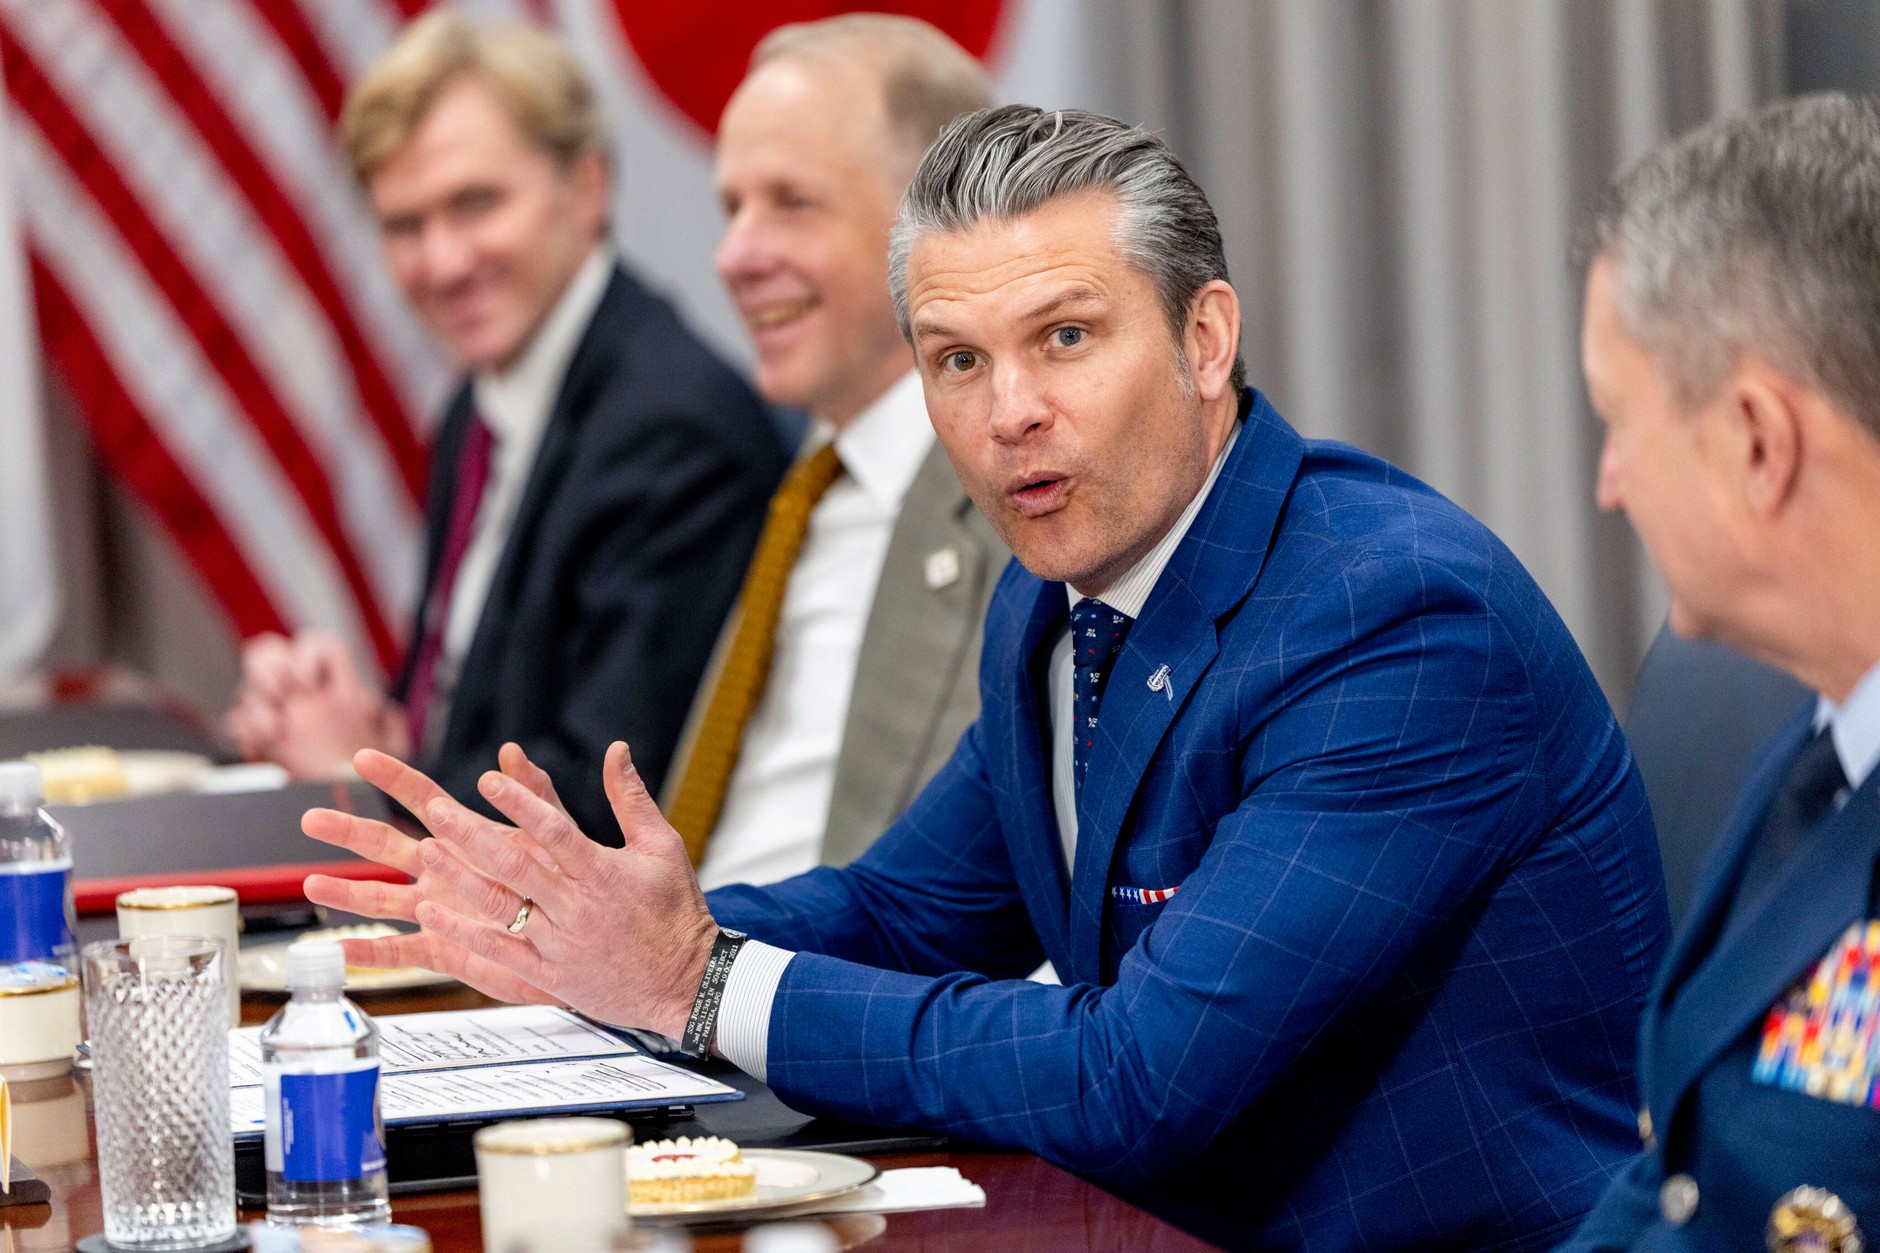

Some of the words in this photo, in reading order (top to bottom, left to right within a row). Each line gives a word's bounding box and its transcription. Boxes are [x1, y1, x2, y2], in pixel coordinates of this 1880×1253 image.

[691, 1000, 702, 1020] JORGE
[702, 956, 718, 988] OLIVEIRA
[701, 996, 712, 1019] 113th
[712, 967, 722, 984] 50th
[719, 950, 728, 965] IBCT
[724, 961, 733, 973] OCT
[729, 945, 738, 959] 2011
